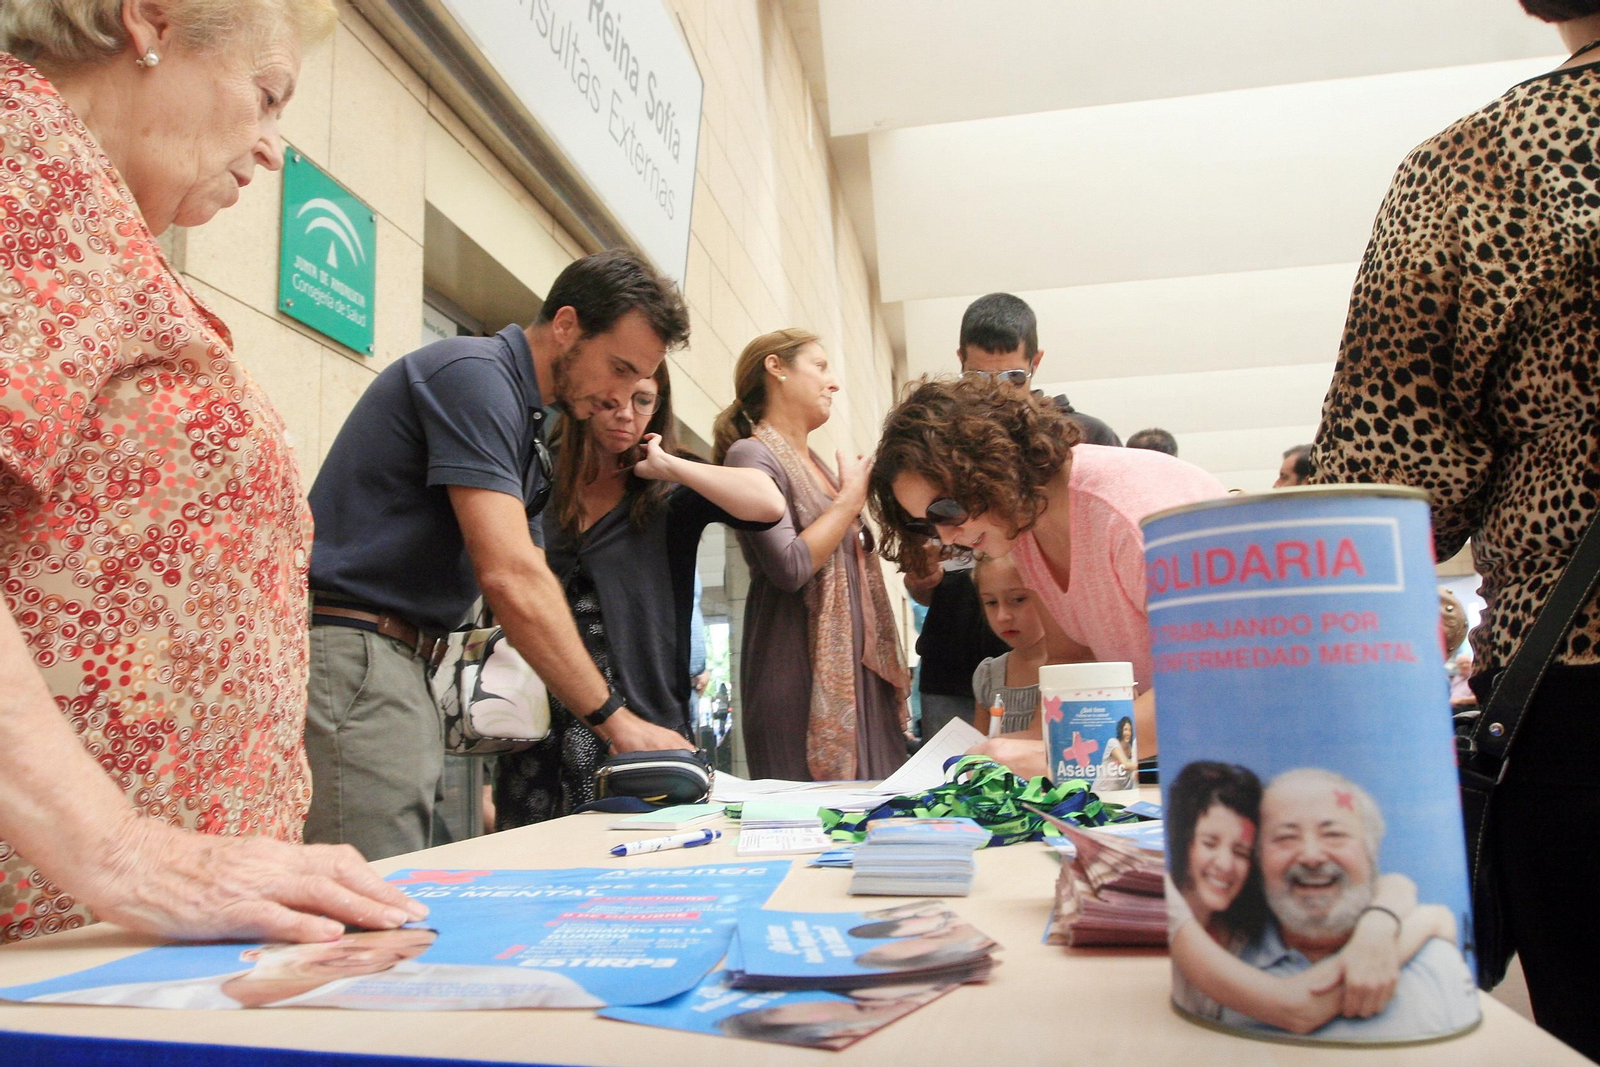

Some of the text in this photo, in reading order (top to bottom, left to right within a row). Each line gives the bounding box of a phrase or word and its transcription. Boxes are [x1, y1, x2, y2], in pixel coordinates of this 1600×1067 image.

[588, 0, 639, 96] Reina
[608, 88, 675, 221] Externas
[1321, 611, 1380, 634] POR
[1319, 641, 1419, 664] MENTAL
[1057, 760, 1127, 777] Asaenec
[458, 888, 604, 898] MENTAL
